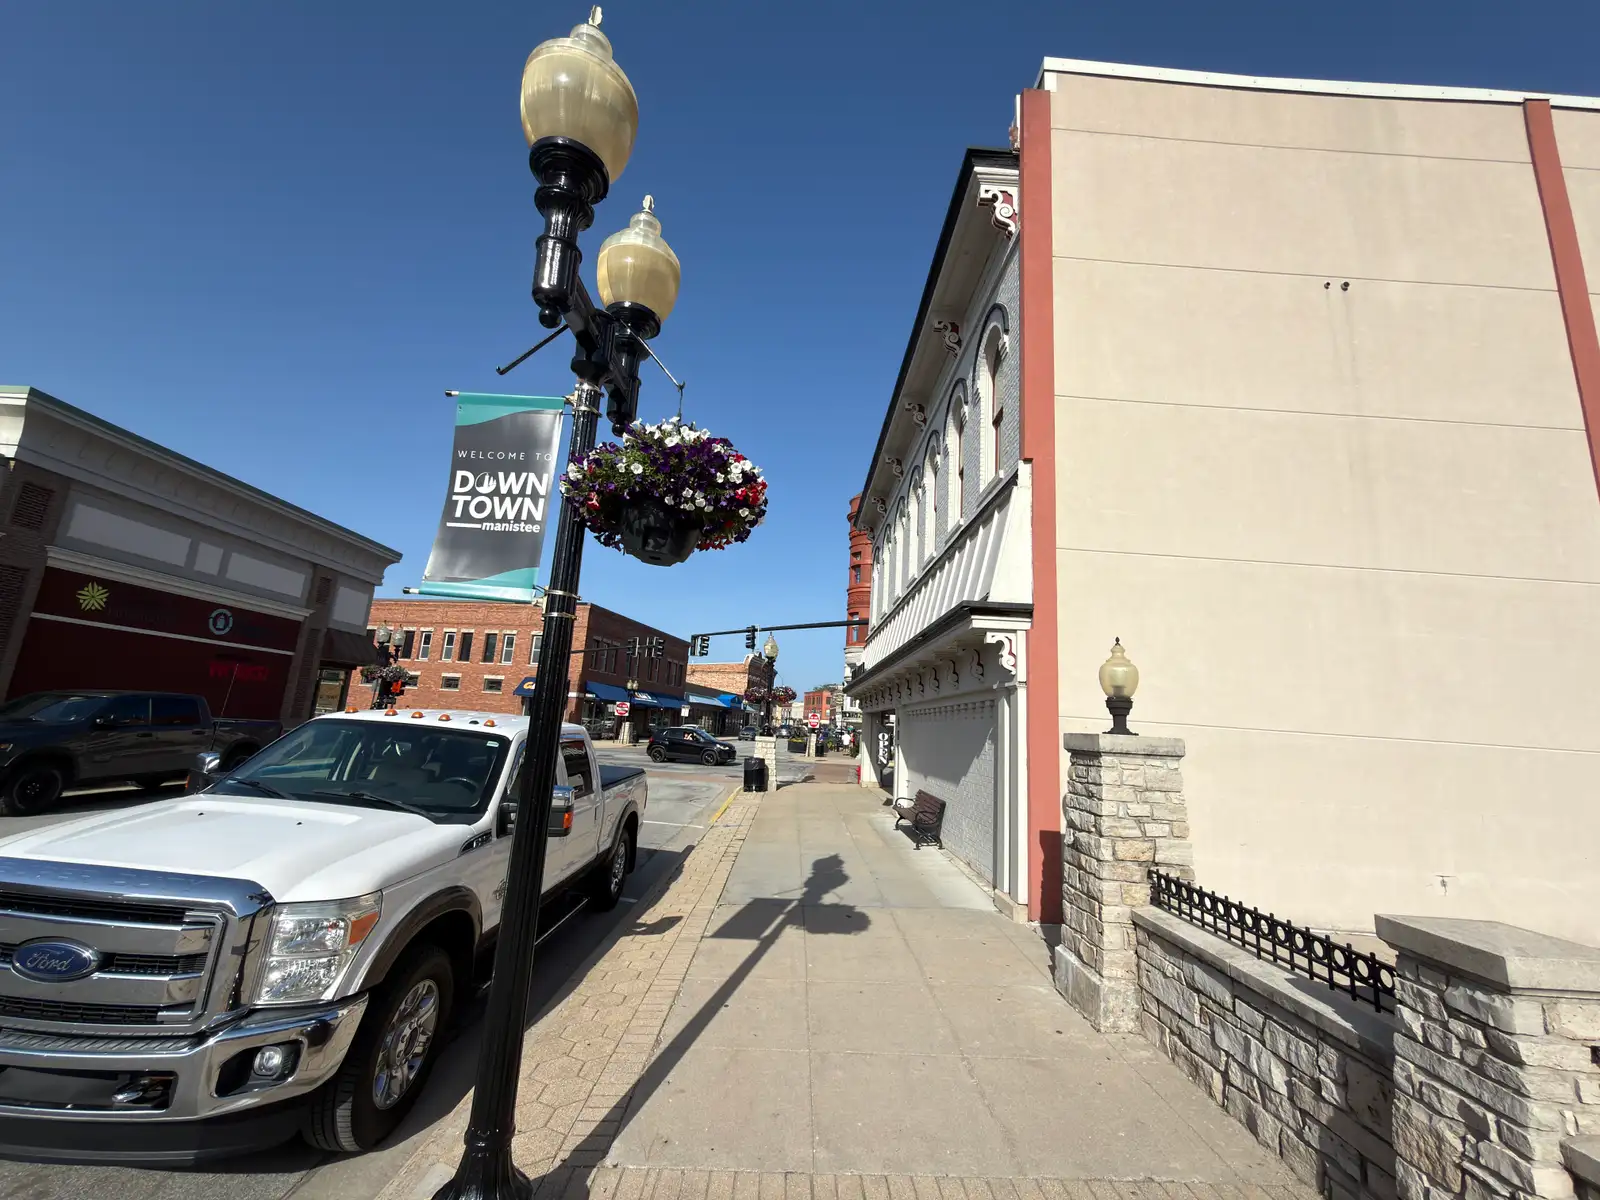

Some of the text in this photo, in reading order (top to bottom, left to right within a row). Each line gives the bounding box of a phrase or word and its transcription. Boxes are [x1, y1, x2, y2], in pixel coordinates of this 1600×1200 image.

[457, 450, 553, 462] WELCOME TO
[453, 470, 549, 496] DOWN
[451, 494, 545, 521] TOWN
[481, 520, 541, 533] manistee
[878, 732, 889, 765] OPEN
[26, 950, 74, 971] Ford
